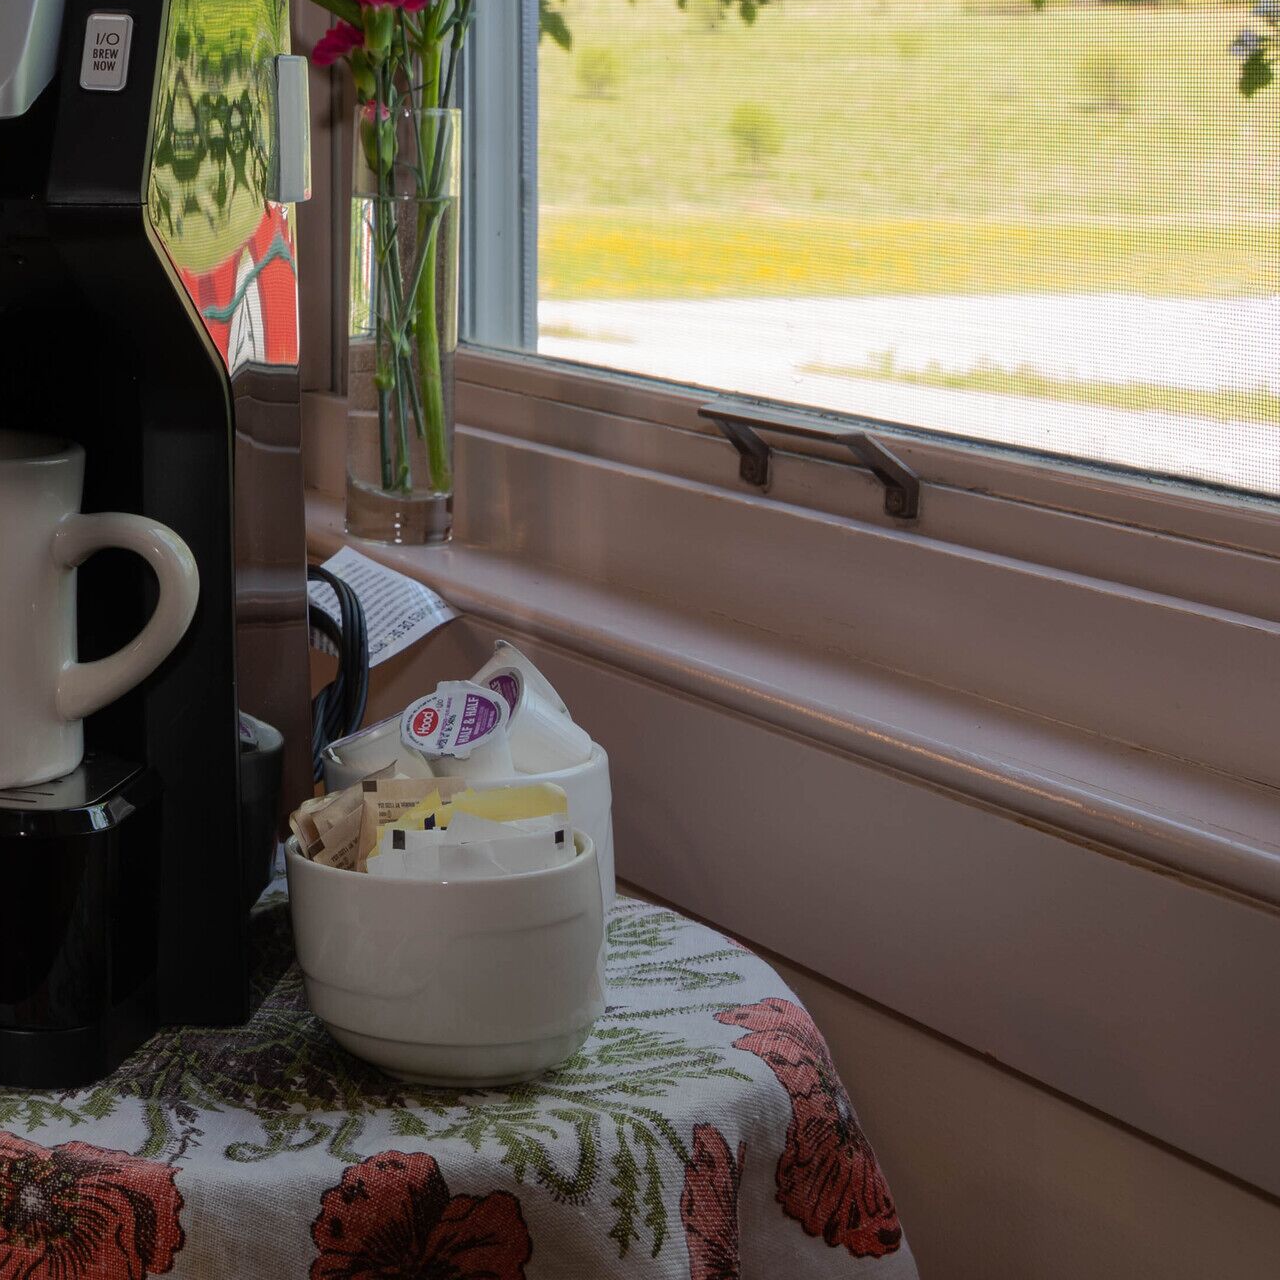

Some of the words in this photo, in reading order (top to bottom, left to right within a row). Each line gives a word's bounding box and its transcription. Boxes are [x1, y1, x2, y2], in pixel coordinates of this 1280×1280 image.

[92, 48, 119, 59] BREW
[93, 60, 116, 71] NOW
[416, 710, 435, 735] Hood
[456, 726, 472, 744] HALF
[466, 696, 480, 717] HALF
